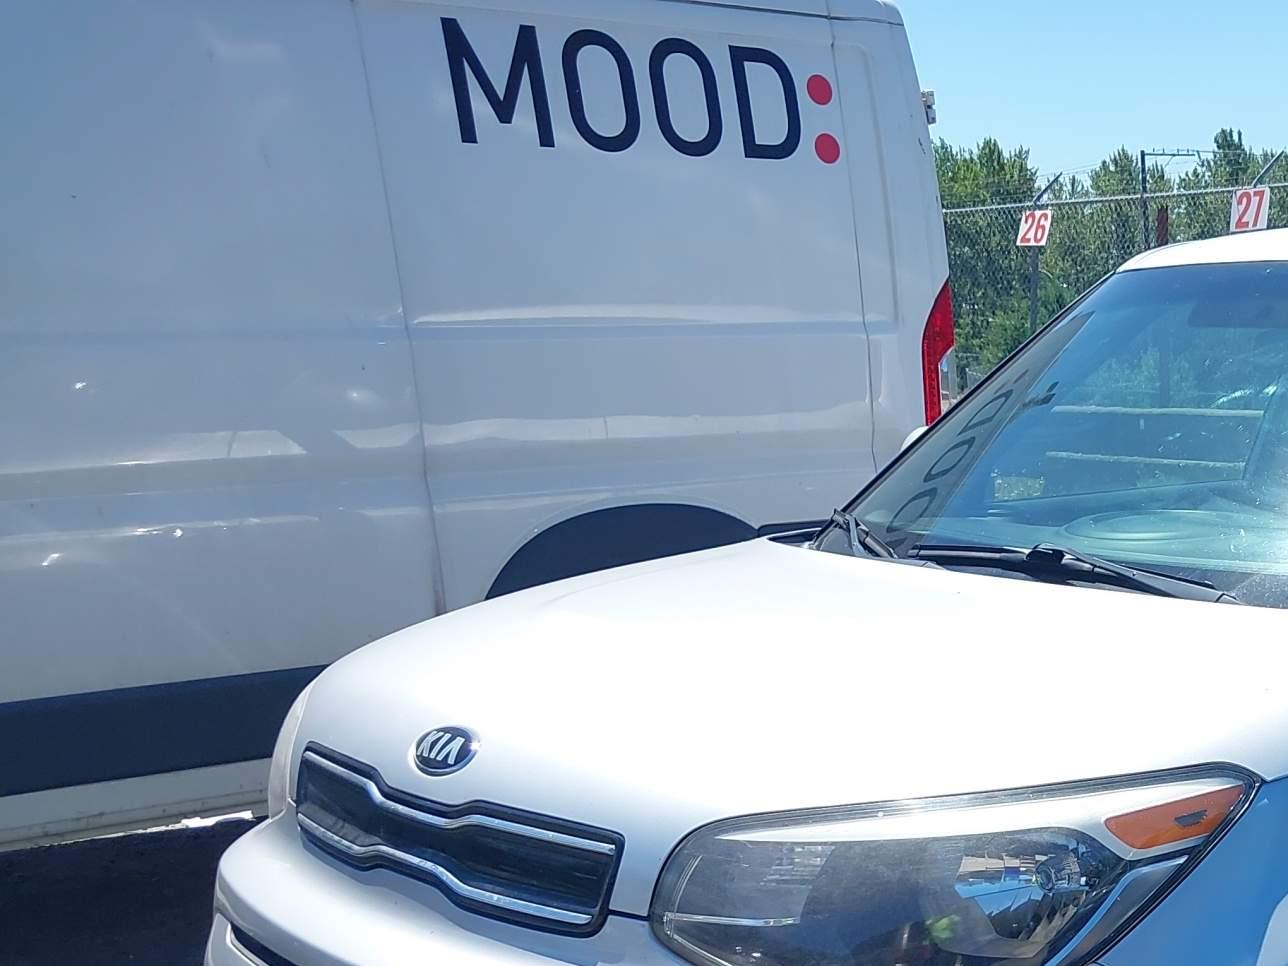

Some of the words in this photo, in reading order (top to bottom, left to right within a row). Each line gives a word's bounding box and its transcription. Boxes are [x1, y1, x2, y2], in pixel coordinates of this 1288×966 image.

[1019, 211, 1049, 244] 26
[1235, 190, 1265, 230] 27
[416, 730, 466, 766] KIA
